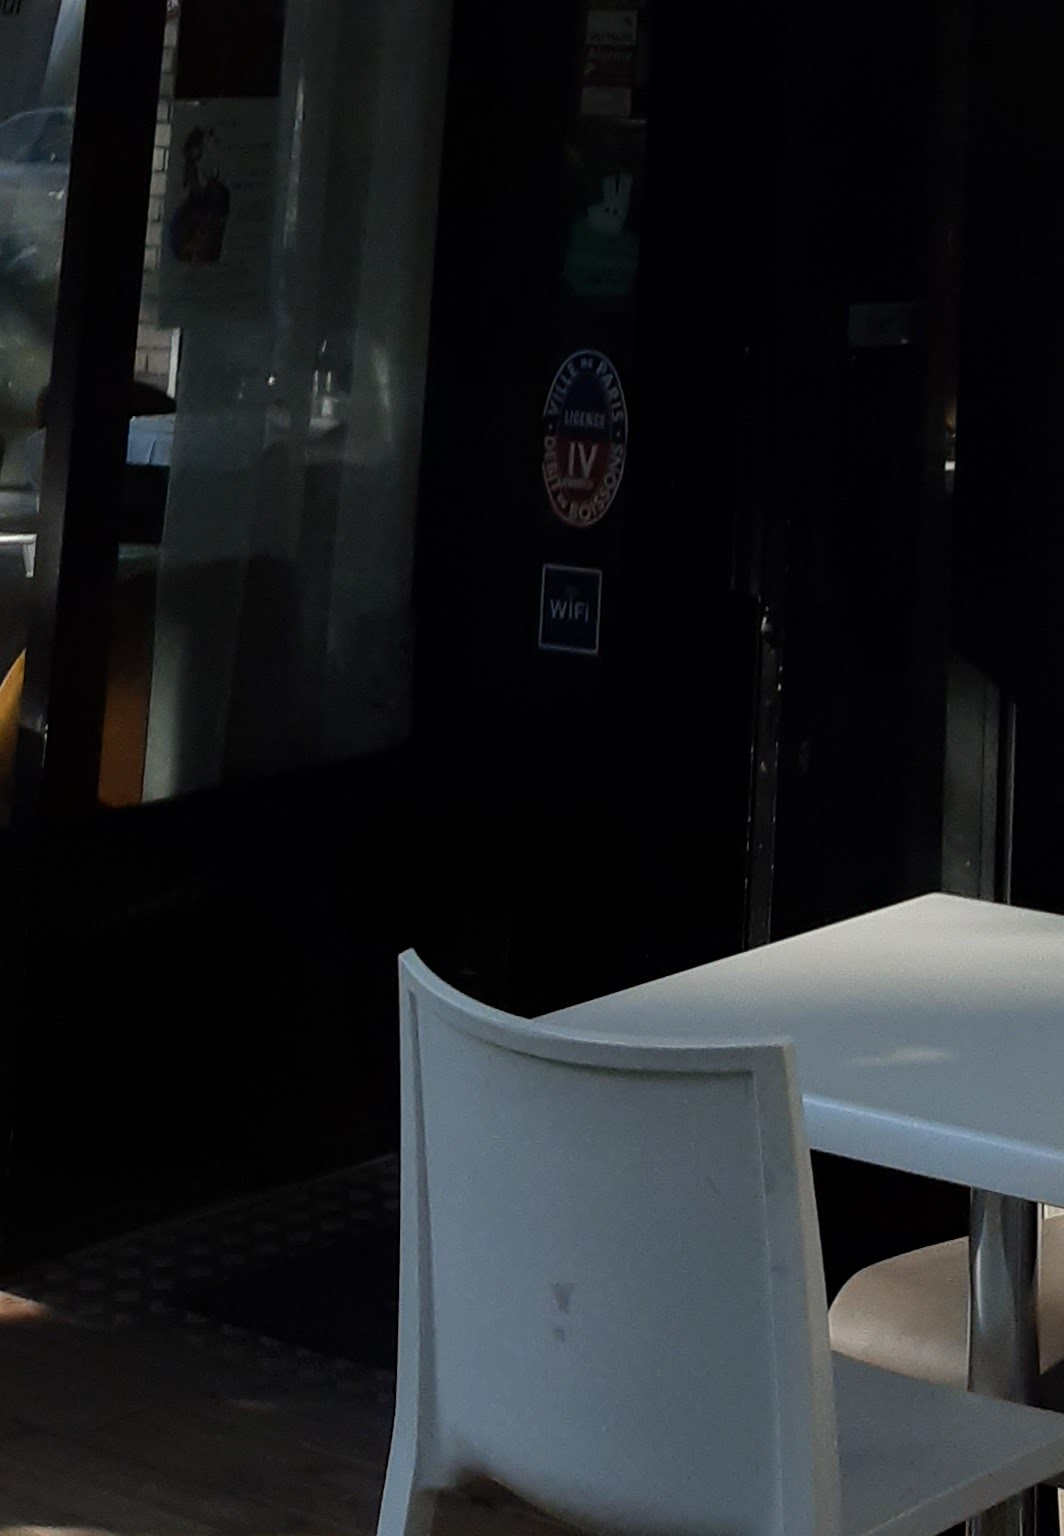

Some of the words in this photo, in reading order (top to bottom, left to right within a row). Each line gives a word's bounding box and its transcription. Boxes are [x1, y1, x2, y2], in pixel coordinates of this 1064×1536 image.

[547, 359, 579, 417] VILLE
[595, 360, 623, 423] PARIS
[567, 440, 600, 480] IV
[568, 443, 625, 521] BOISSONS
